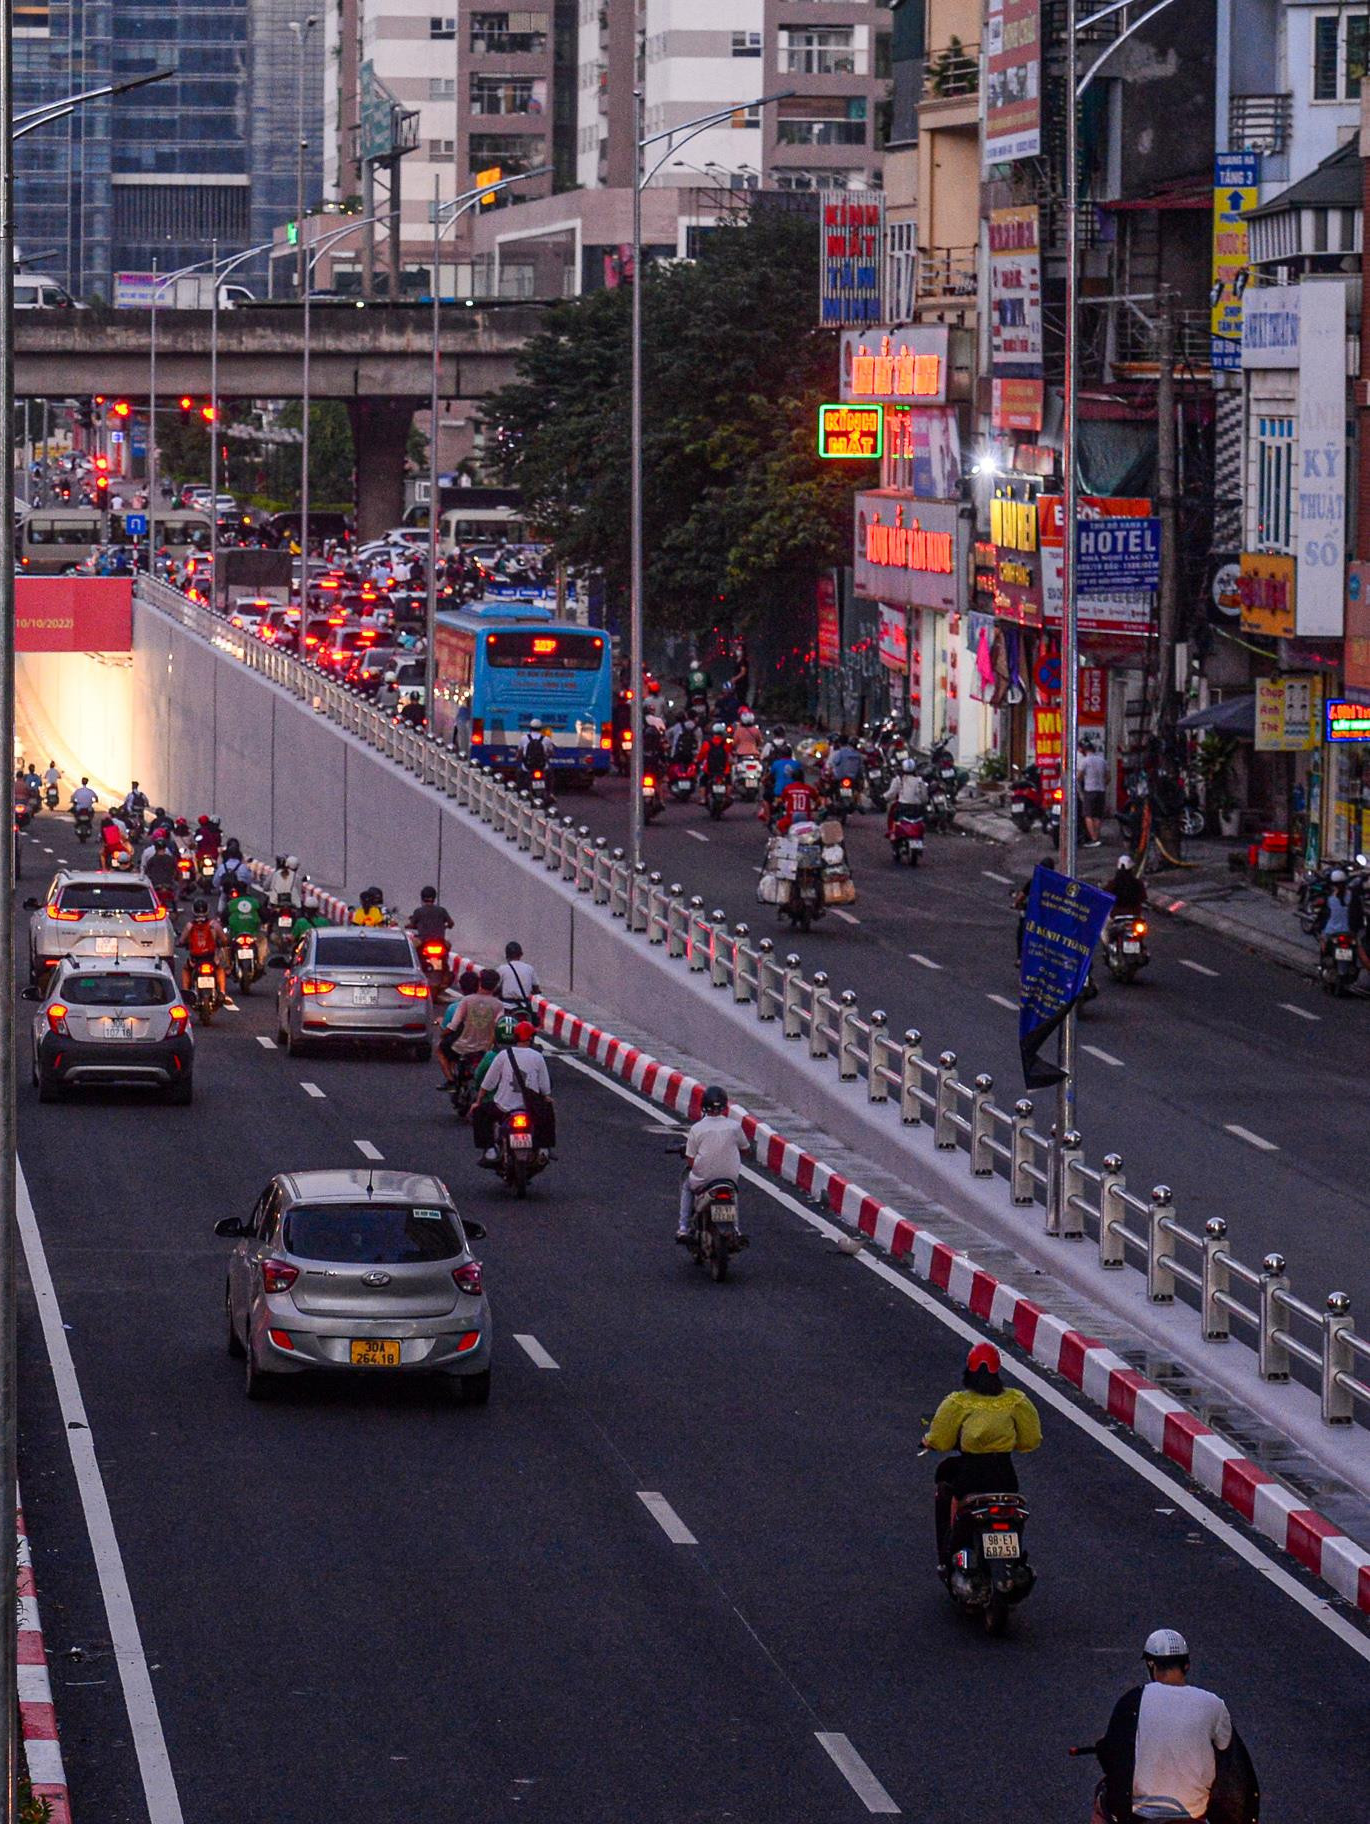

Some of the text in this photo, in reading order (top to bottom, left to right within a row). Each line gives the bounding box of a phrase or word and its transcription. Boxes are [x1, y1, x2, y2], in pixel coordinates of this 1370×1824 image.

[824, 408, 878, 431] KÍNH
[827, 430, 874, 455] MẮT
[1080, 530, 1157, 554] HOTEL
[793, 793, 806, 810] 10
[365, 1341, 385, 1353] 30A
[356, 1353, 394, 1365] 264.18
[985, 1545, 1017, 1558] 687.59
